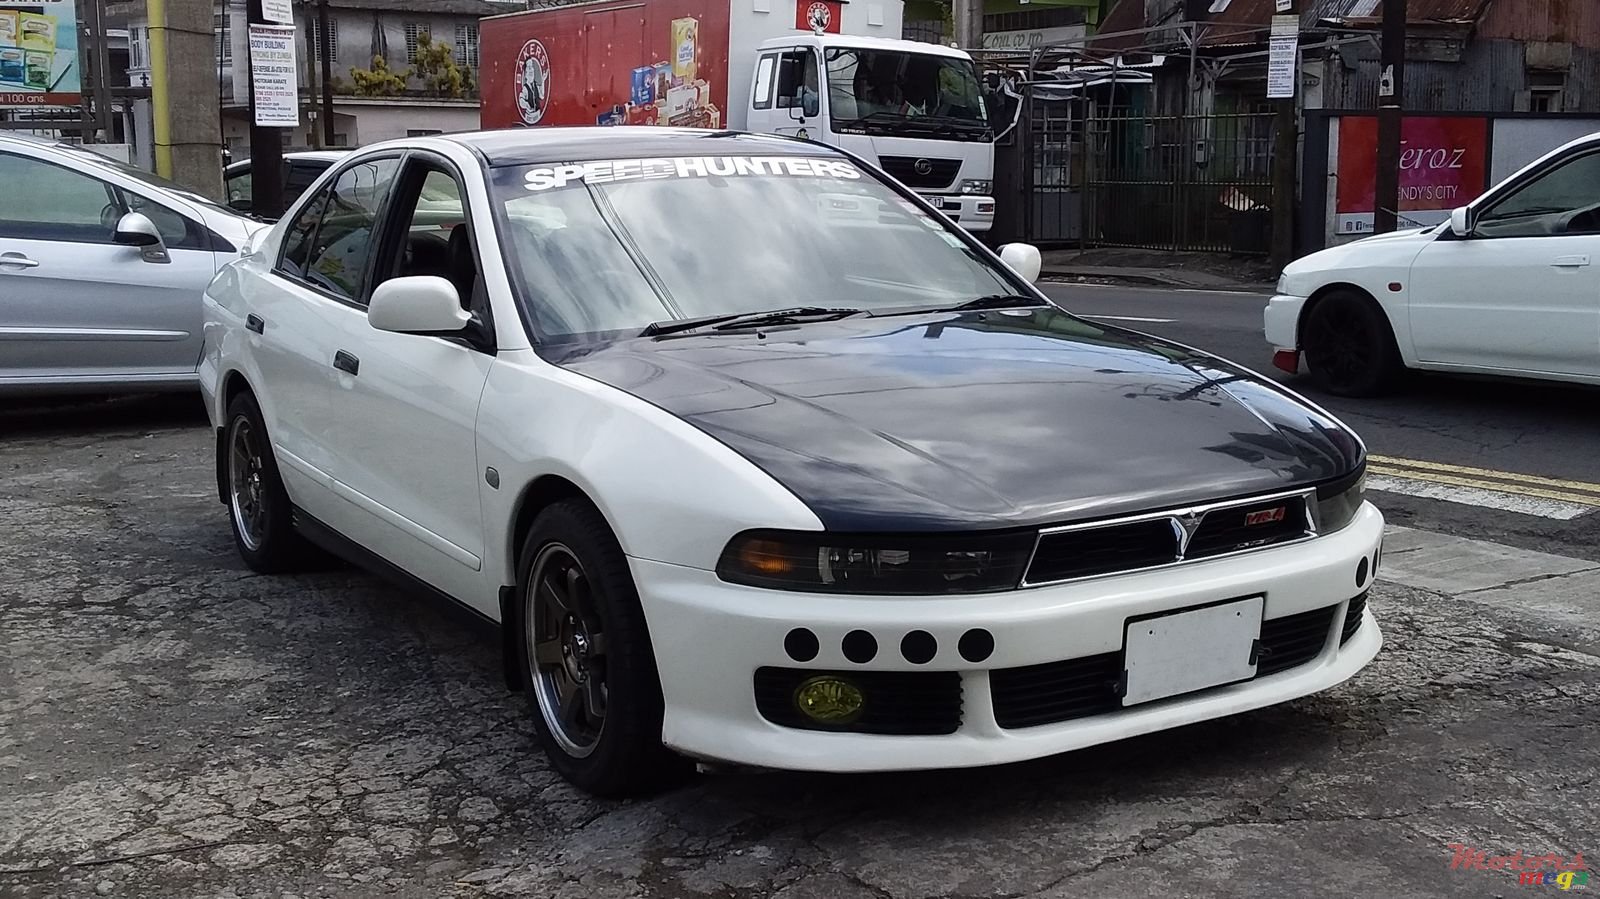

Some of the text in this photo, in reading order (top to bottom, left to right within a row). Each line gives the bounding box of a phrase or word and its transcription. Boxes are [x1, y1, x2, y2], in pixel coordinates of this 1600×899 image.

[265, 40, 286, 50] BUILDING
[516, 43, 547, 84] BAKERS
[7, 93, 25, 103] 100
[26, 95, 47, 104] ans.
[523, 156, 862, 191] SPEEDHUNTERS
[1434, 184, 1459, 199] CITY
